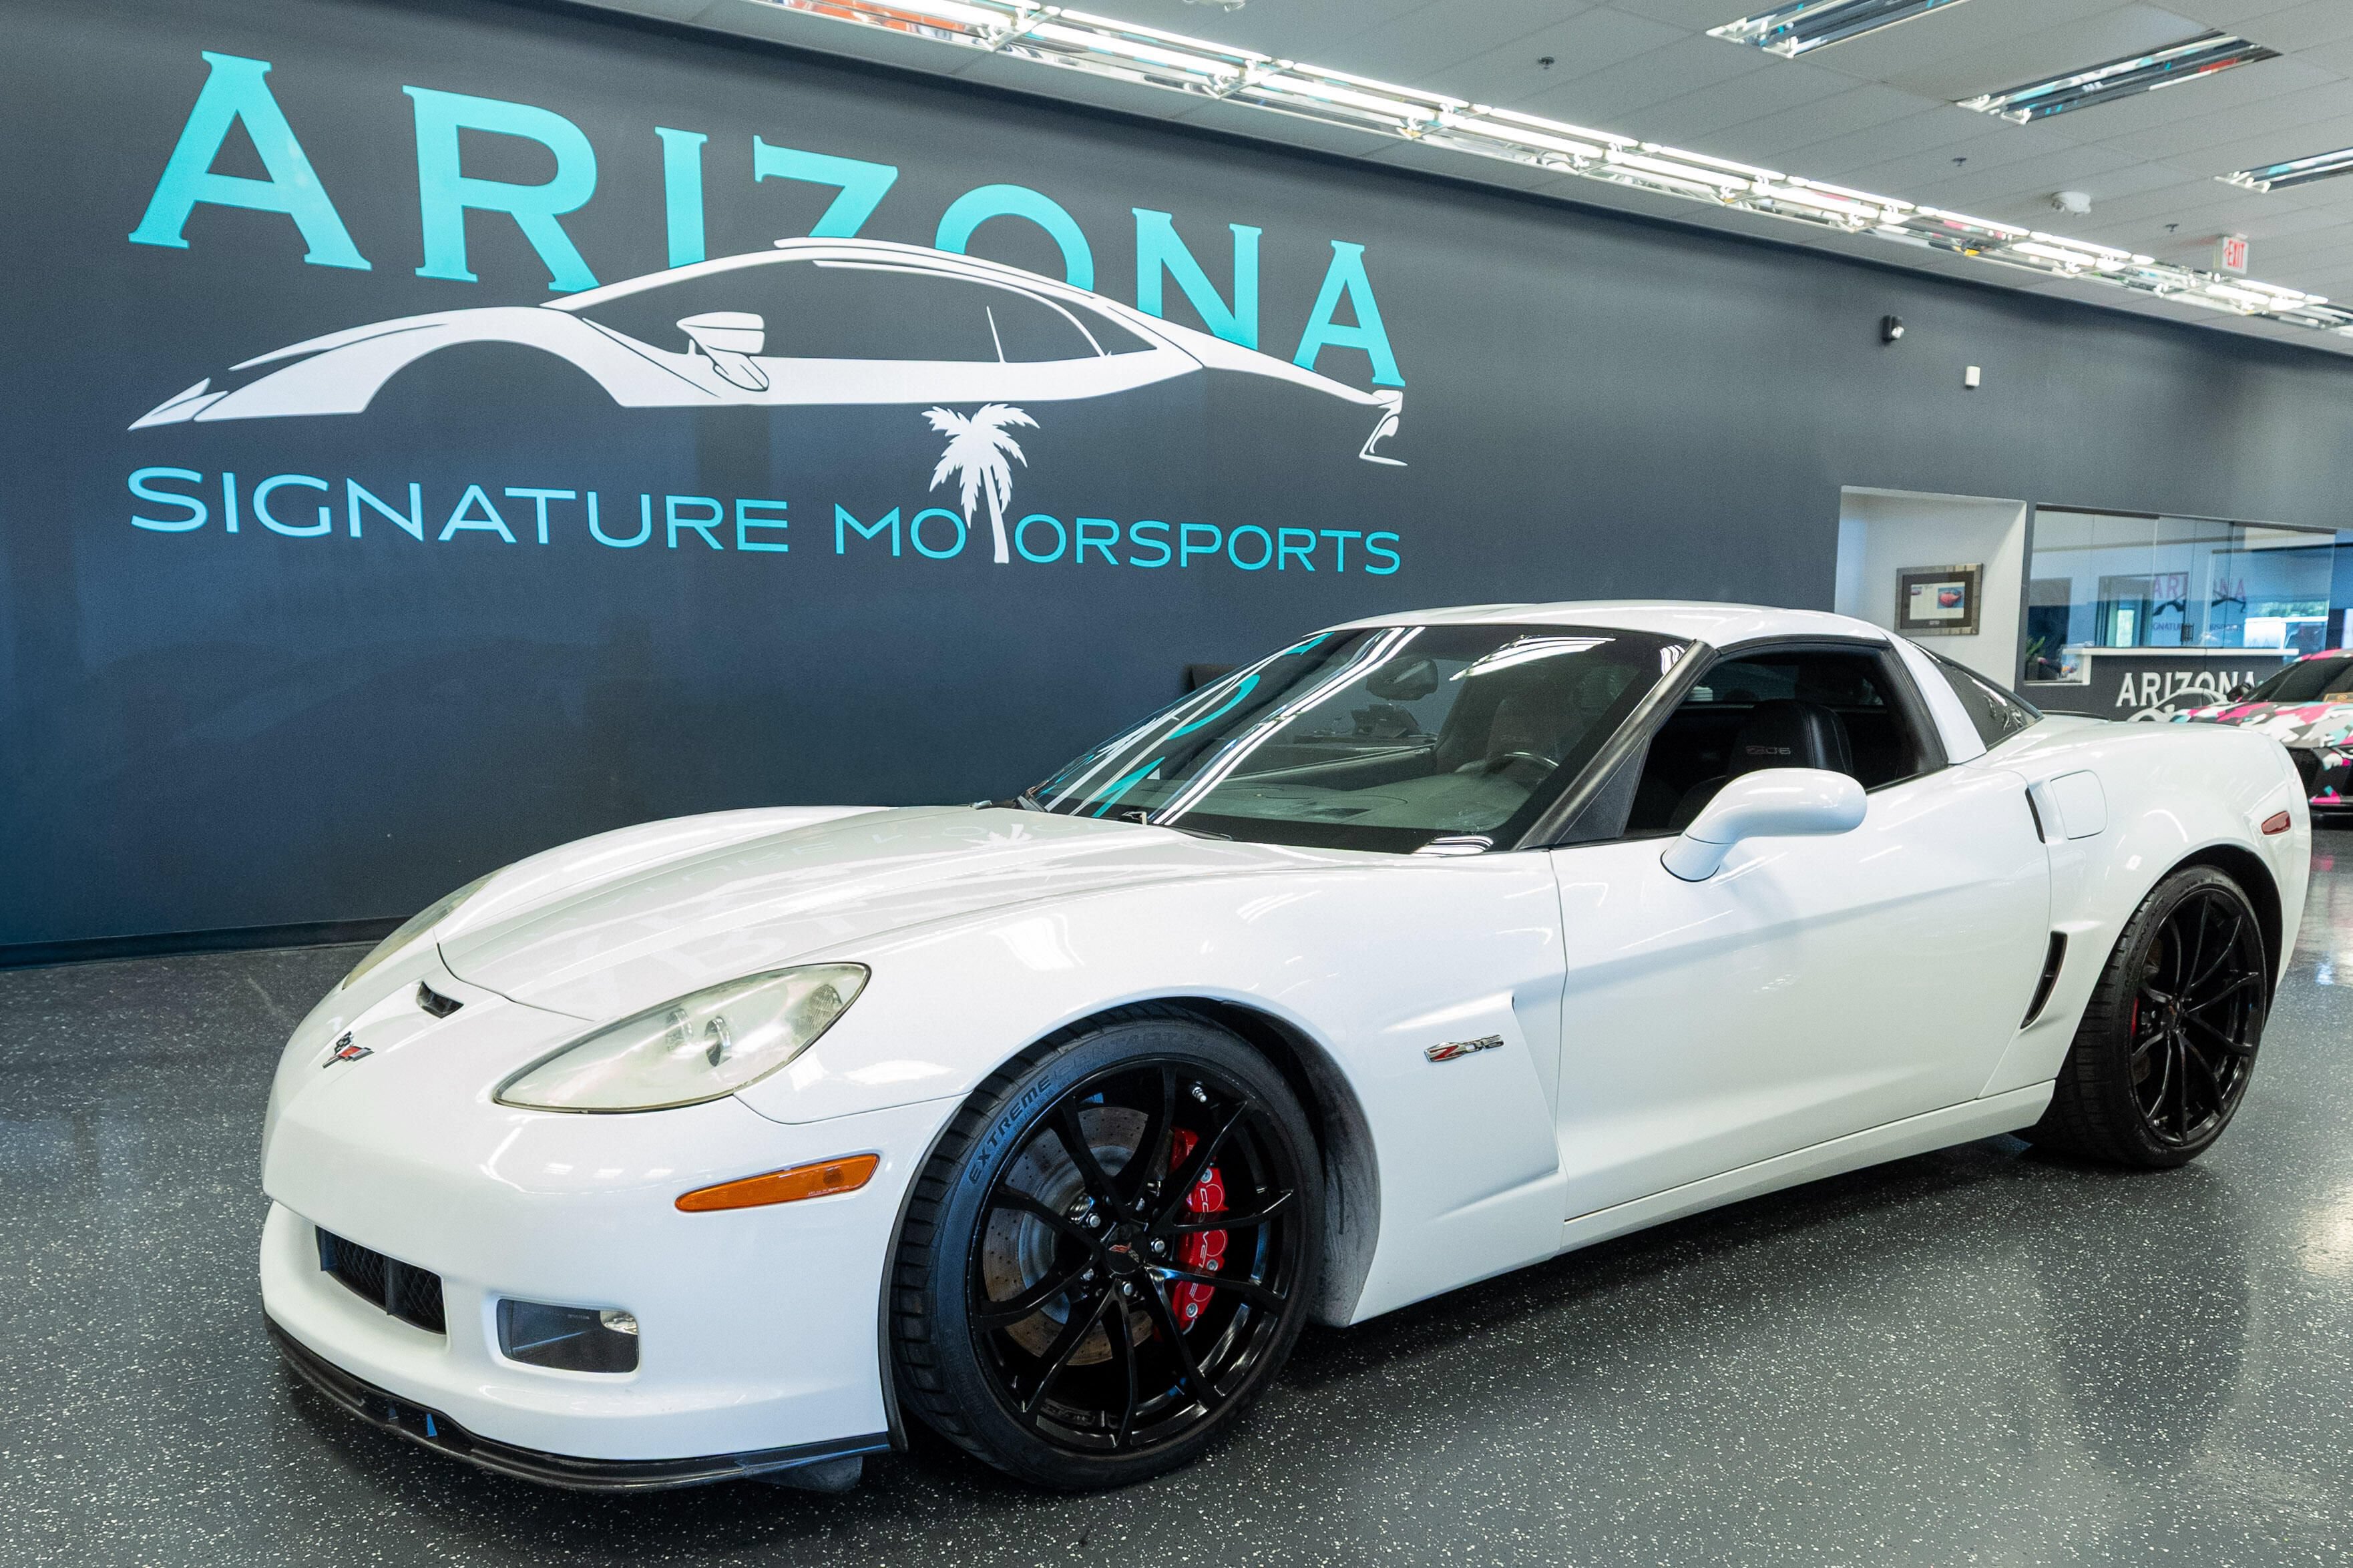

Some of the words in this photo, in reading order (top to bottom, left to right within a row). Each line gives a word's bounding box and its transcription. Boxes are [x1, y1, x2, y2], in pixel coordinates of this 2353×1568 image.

[127, 50, 1406, 388] ARIZONA
[2227, 238, 2245, 270] EXIT
[127, 466, 790, 553] SIGNATURE
[1424, 1034, 1504, 1063] Z06
[968, 1075, 1052, 1185] EXTREME
[1189, 1188, 1209, 1298] COVETE
